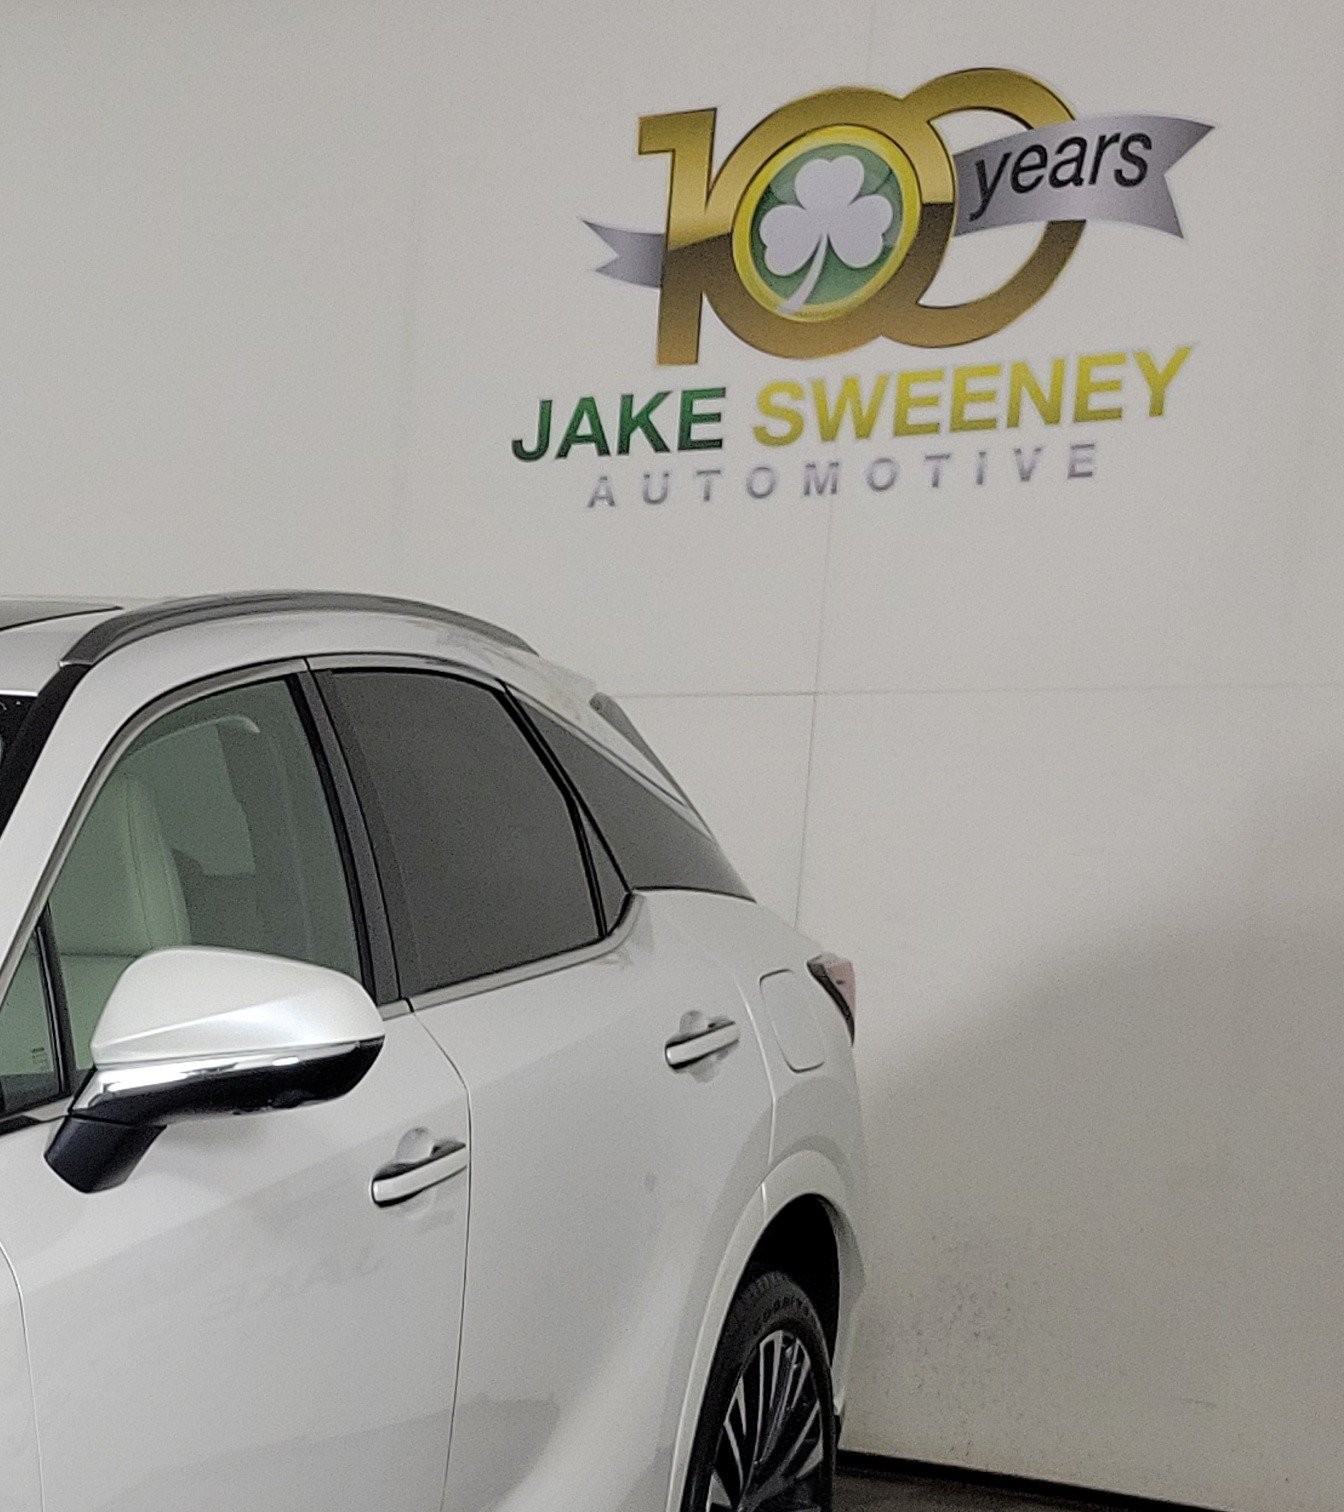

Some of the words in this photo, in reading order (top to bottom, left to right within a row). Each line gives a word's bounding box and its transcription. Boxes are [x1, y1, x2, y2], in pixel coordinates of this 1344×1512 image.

[968, 128, 1154, 222] years
[512, 386, 727, 462] JAKE
[752, 346, 1193, 447] SWEENEY
[588, 443, 1097, 508] AUTOMOTIVE
